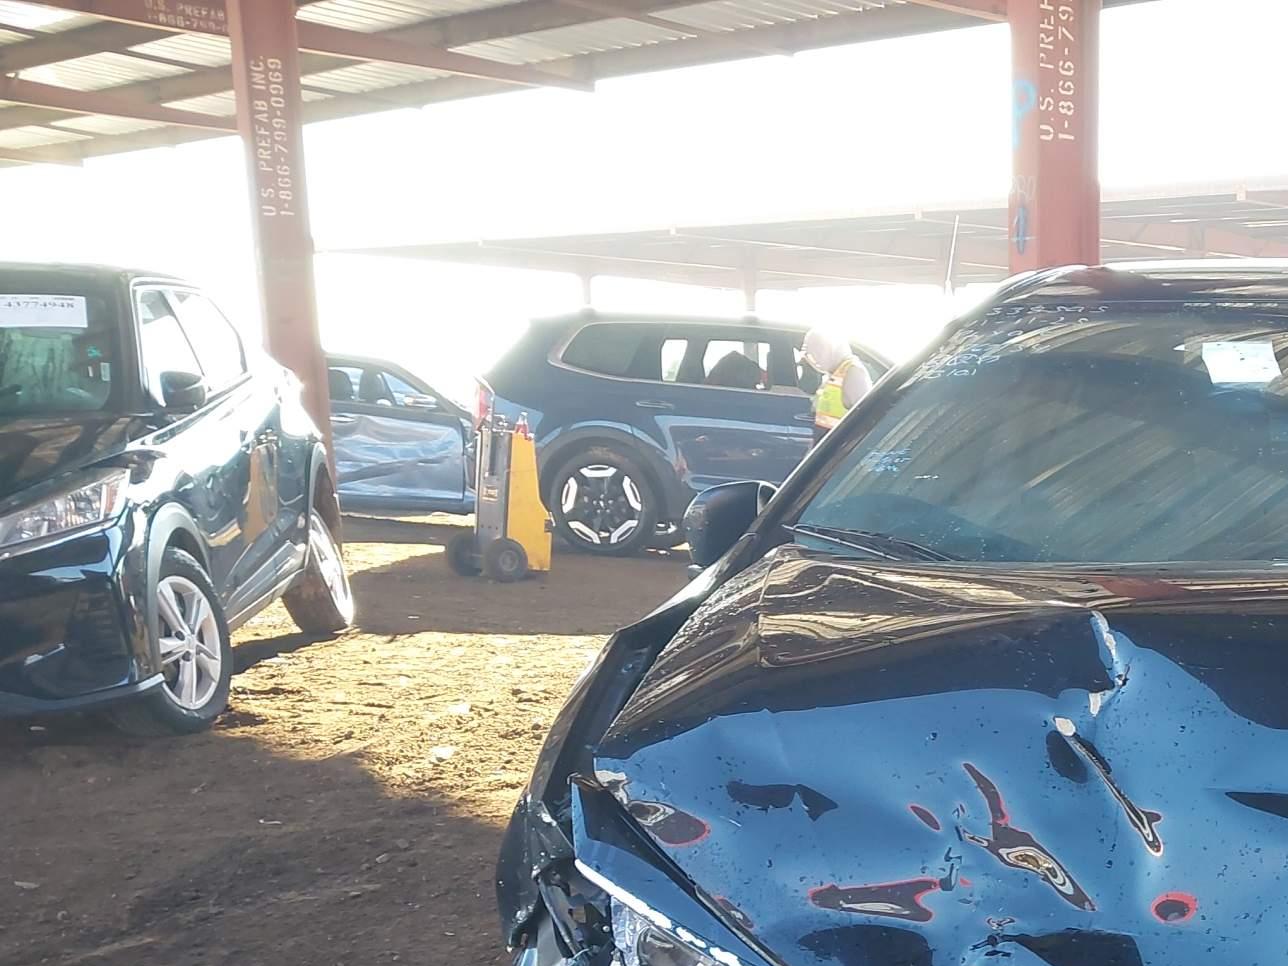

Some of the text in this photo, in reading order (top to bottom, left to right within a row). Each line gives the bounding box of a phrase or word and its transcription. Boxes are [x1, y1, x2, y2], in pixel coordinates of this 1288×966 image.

[250, 55, 267, 90] INC.
[1058, 0, 1075, 141] 1-866-79
[253, 100, 274, 172] PREFAB
[266, 57, 295, 217] 1-866-799-0969
